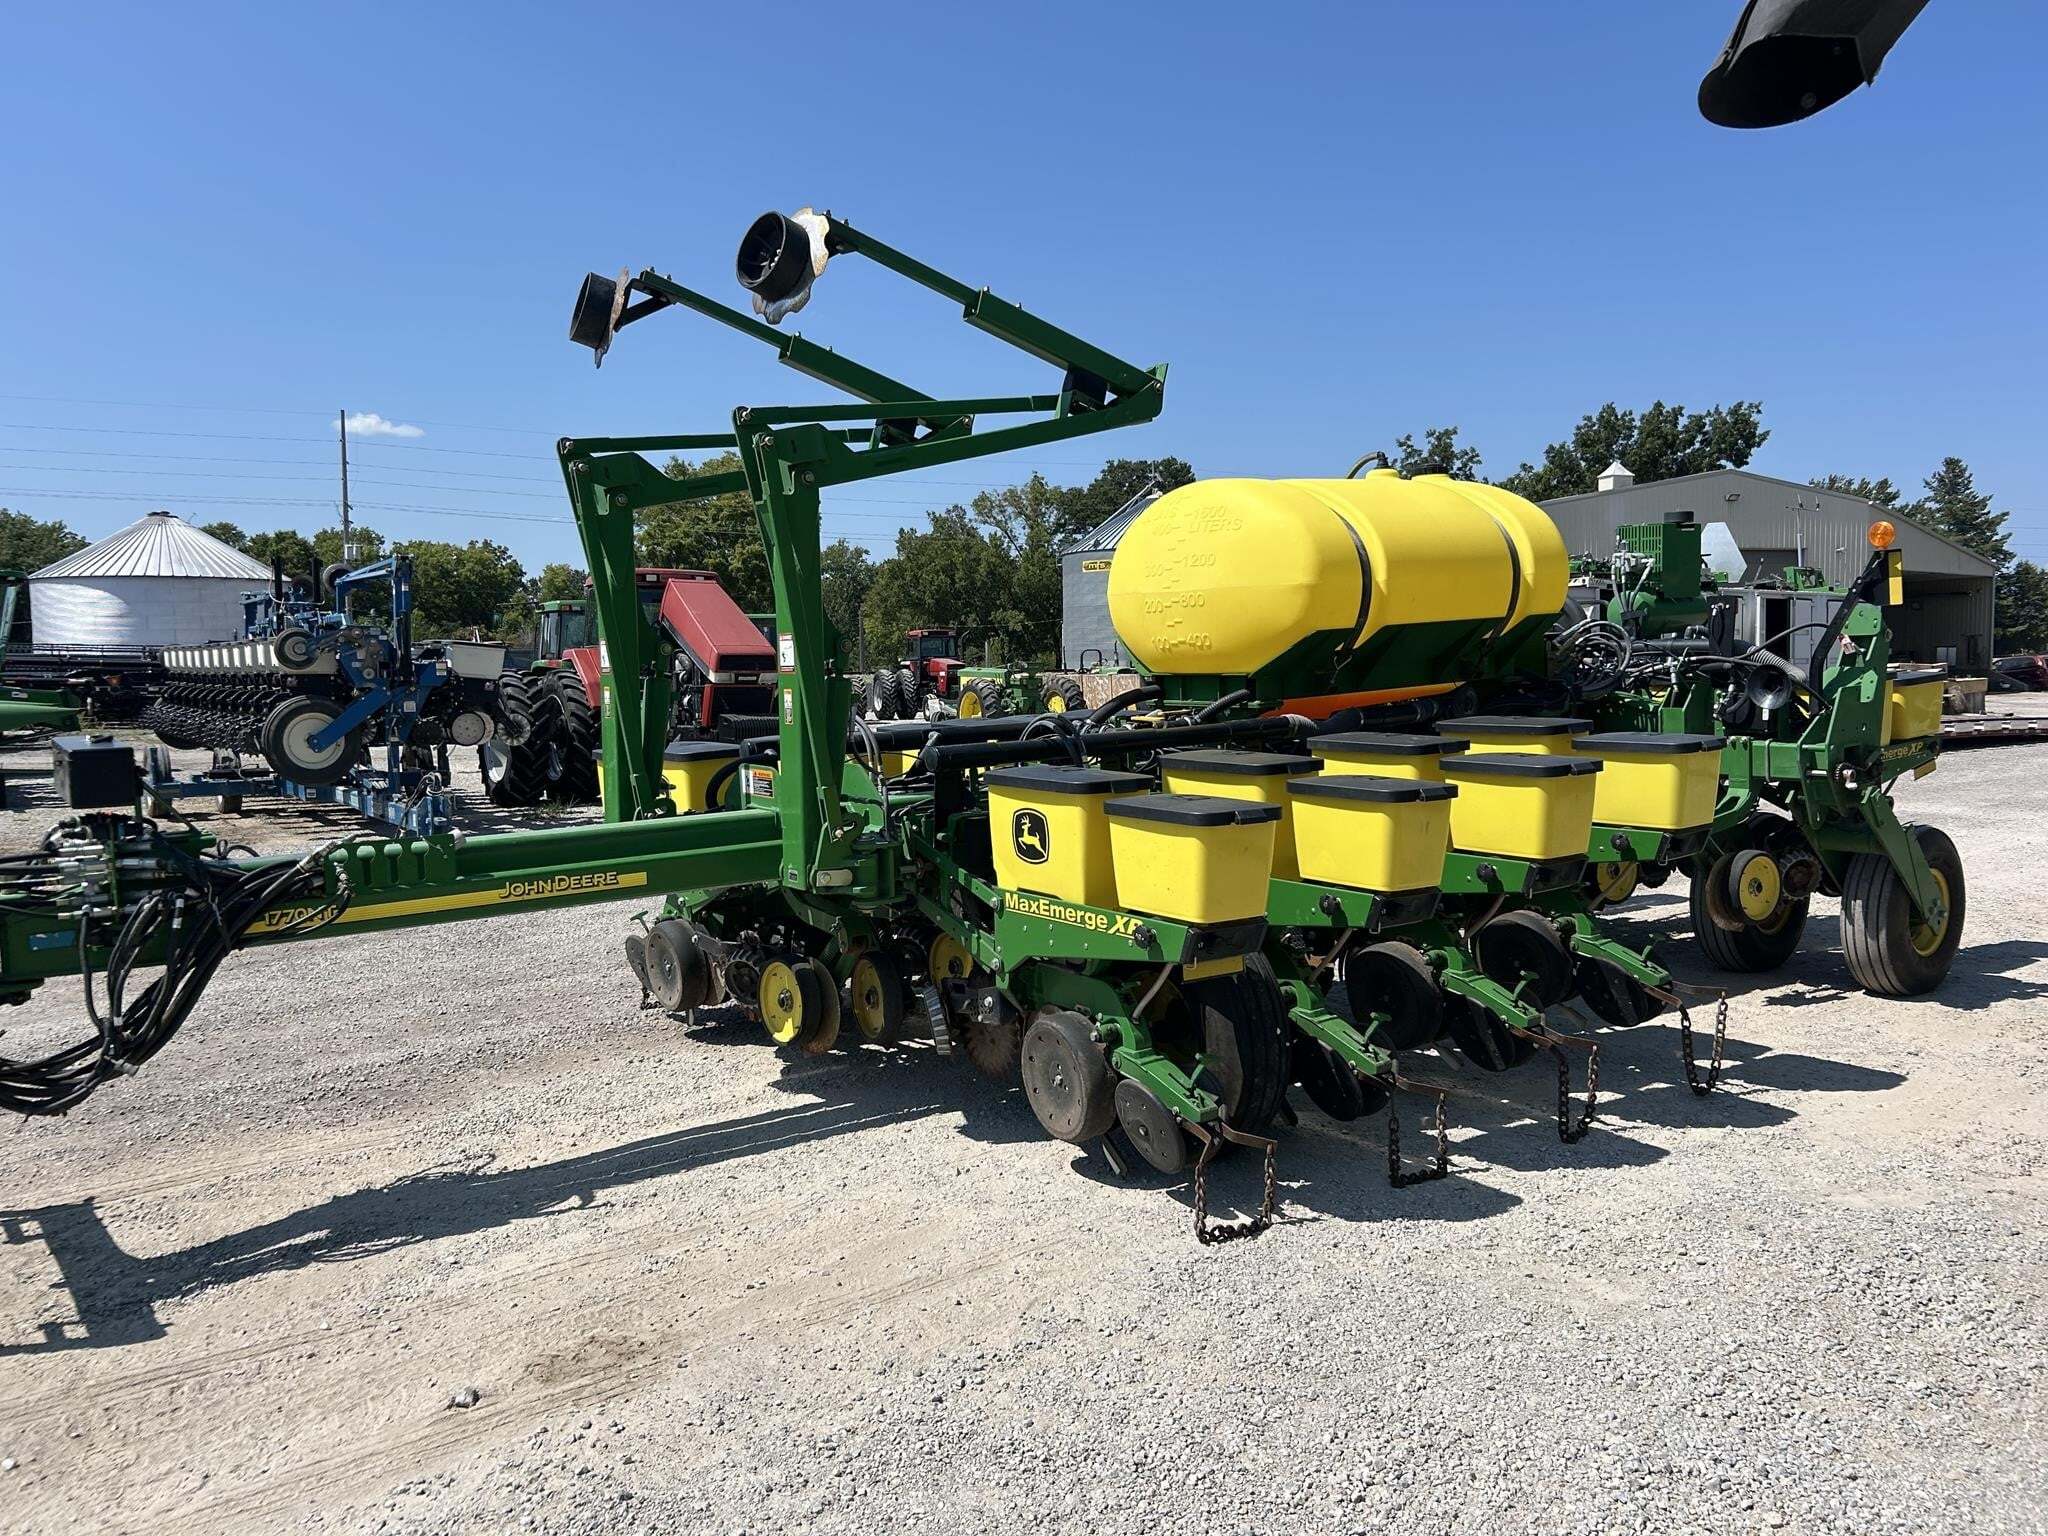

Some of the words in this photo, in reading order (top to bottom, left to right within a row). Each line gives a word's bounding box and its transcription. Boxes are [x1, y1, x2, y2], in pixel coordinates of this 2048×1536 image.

[1188, 518, 1243, 533] LITERS
[1183, 552, 1216, 567] 1200
[1145, 599, 1164, 614] 200
[1186, 632, 1212, 650] 400
[1908, 741, 1924, 756] XP
[499, 880, 552, 899] JOHN
[554, 871, 618, 891] DEERE
[1004, 892, 1108, 930] MaxEmerge
